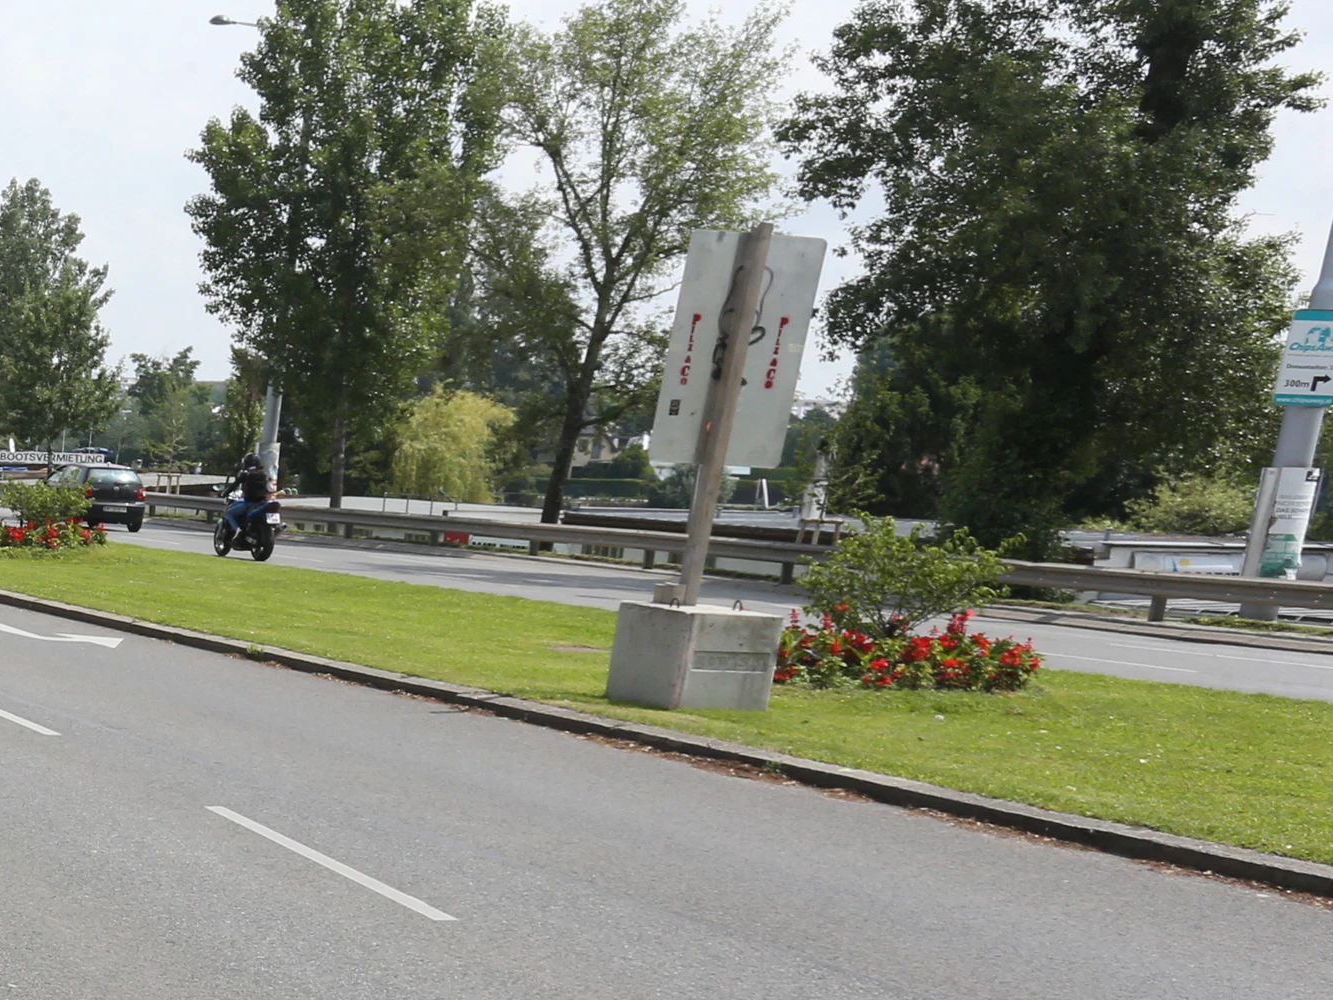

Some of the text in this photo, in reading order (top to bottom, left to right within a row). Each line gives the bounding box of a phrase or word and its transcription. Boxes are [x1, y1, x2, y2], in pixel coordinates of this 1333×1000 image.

[1289, 342, 1333, 352] ChipsAw
[1284, 380, 1309, 388] 300m
[0, 452, 103, 463] BOOTSVERMIETUNG
